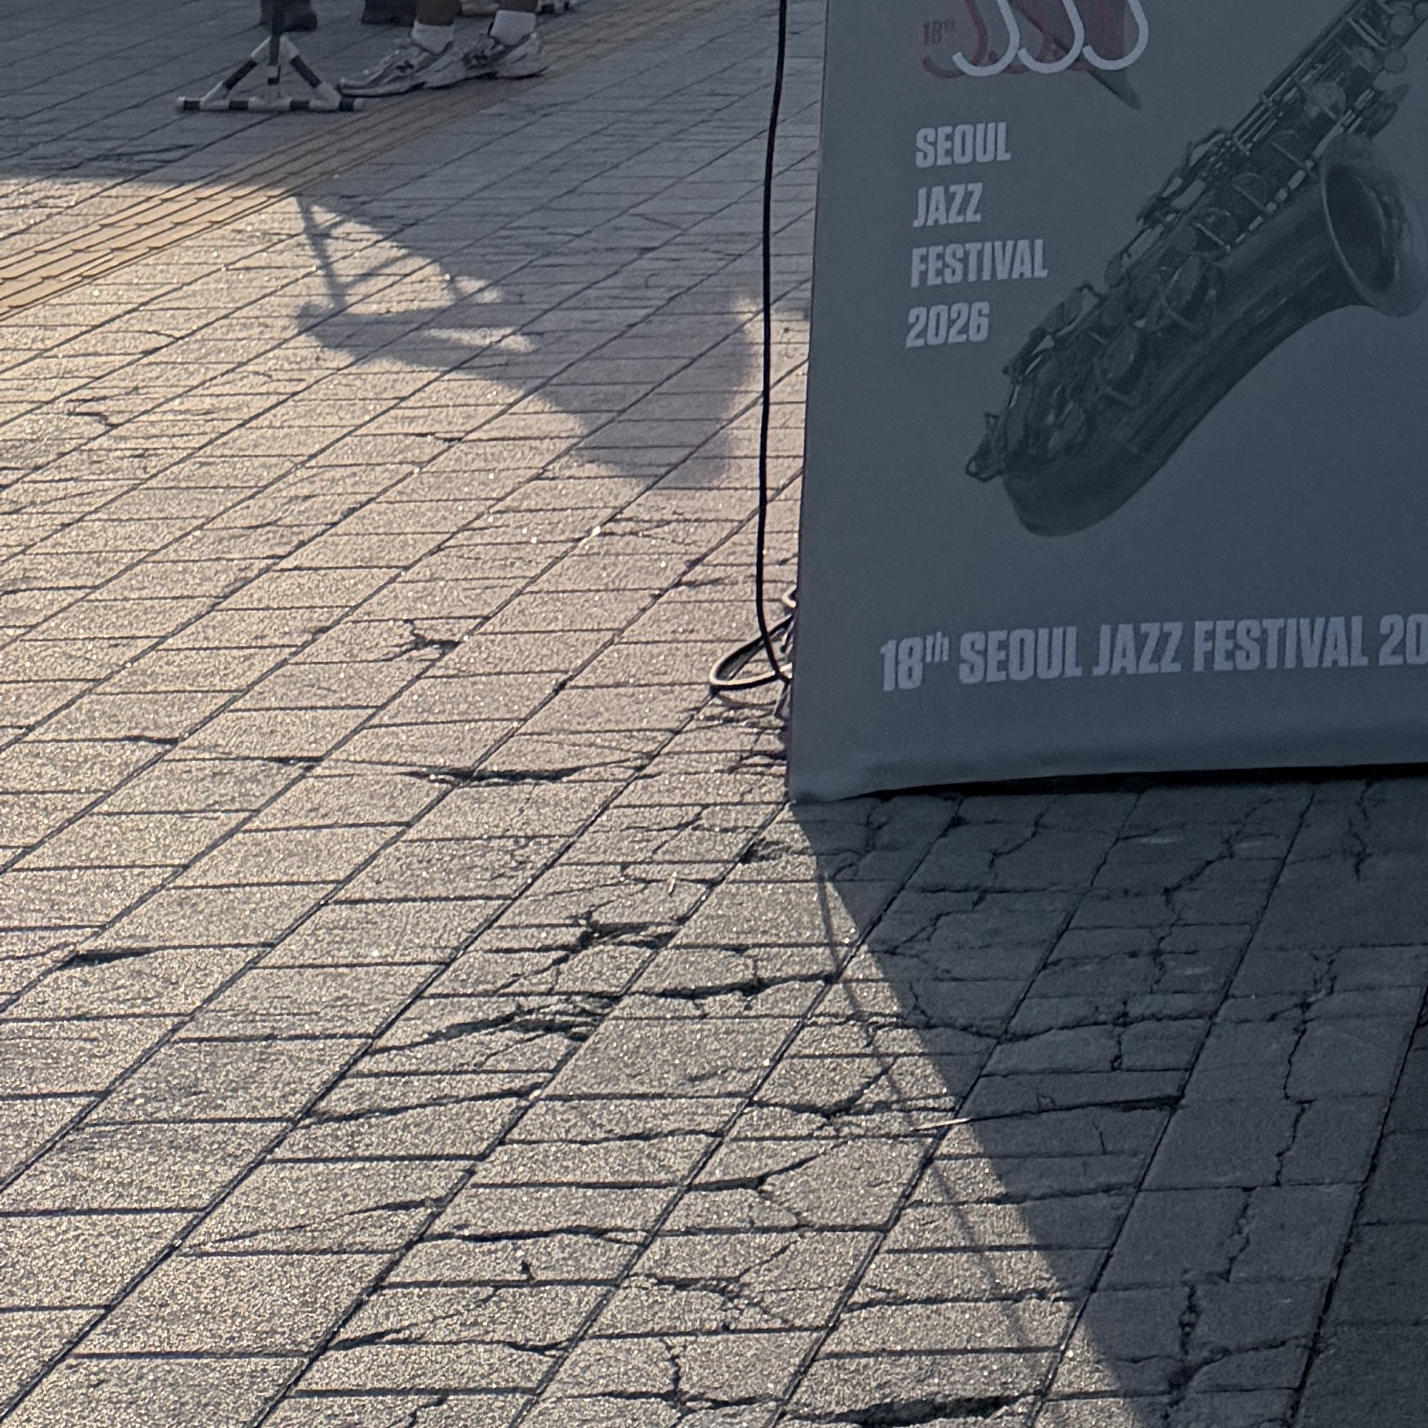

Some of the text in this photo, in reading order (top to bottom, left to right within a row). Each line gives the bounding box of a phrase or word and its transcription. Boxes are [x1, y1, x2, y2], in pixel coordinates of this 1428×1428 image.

[914, 122, 1011, 171] SEOUL
[912, 182, 982, 229] JAZZ
[910, 238, 1048, 289] FESTIVAL
[905, 301, 990, 349] 2026
[880, 630, 949, 691] 18th
[958, 626, 1082, 684] SEOUL
[1092, 621, 1184, 677] JAZZ
[1194, 615, 1369, 672] FESTIVAL
